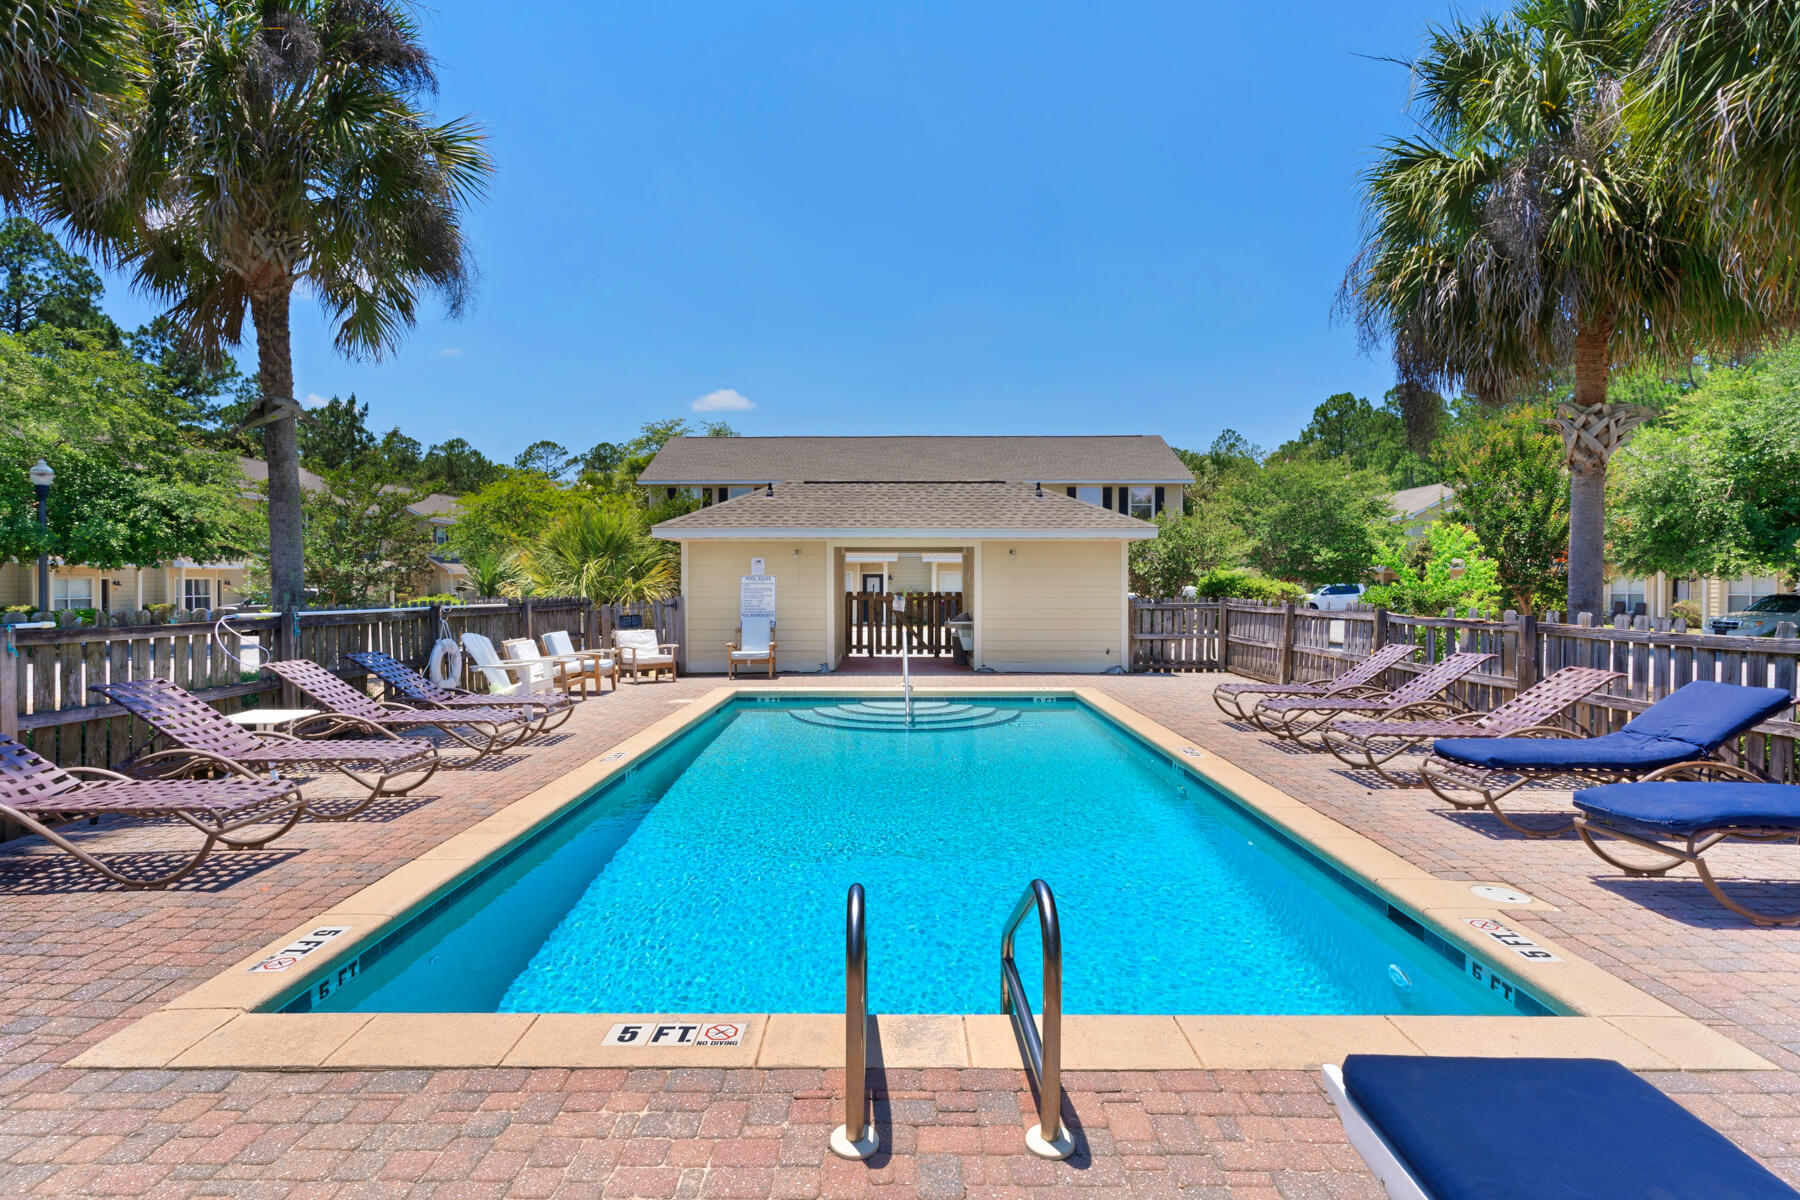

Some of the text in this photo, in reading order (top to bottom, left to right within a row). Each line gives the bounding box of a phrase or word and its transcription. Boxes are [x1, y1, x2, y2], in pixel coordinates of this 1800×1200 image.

[1519, 950, 1552, 958] 5
[1472, 962, 1482, 981] 5
[319, 979, 330, 1000] 5
[617, 1026, 697, 1043] 5 FT.
